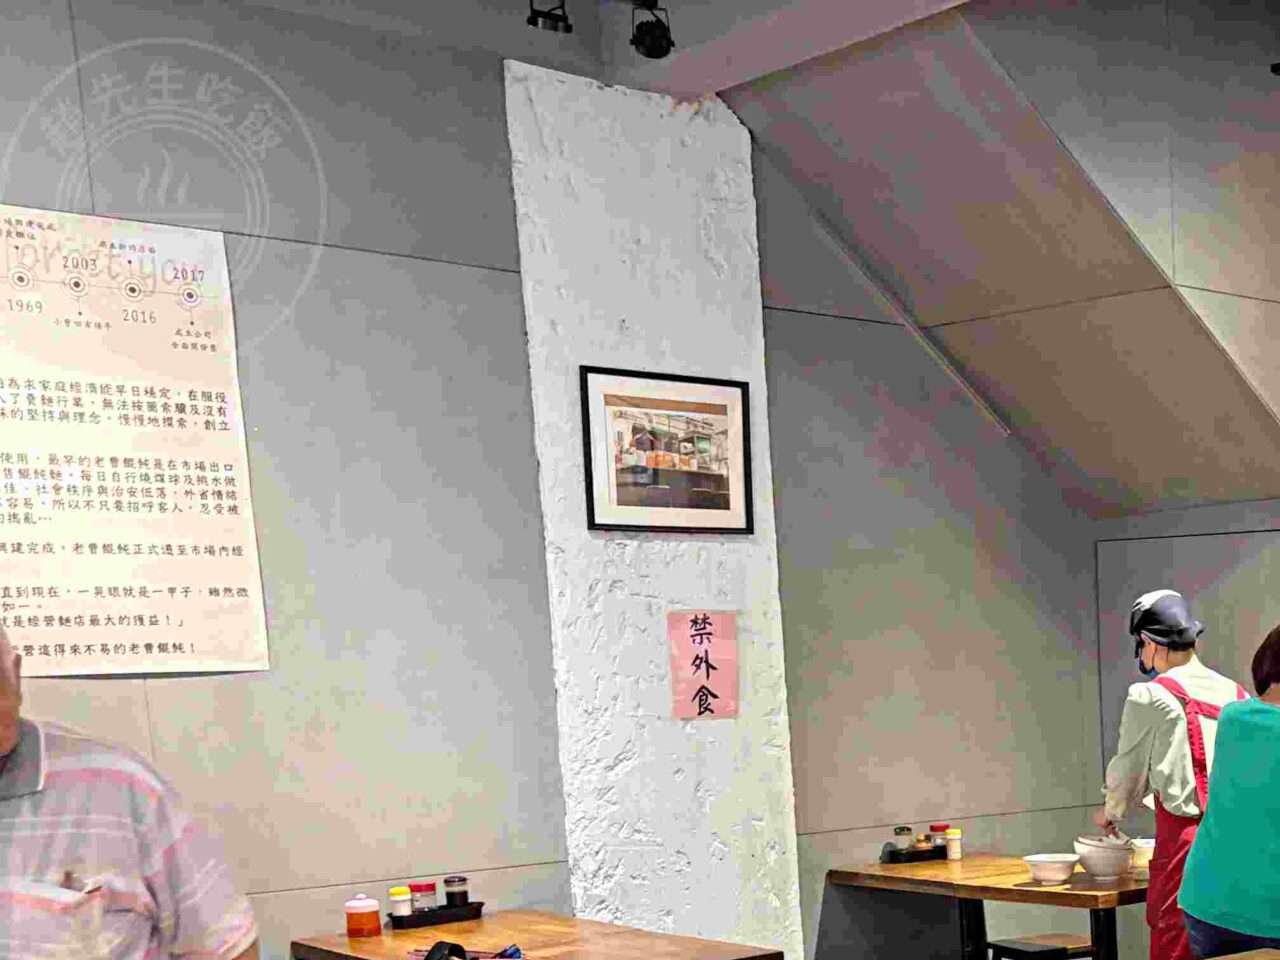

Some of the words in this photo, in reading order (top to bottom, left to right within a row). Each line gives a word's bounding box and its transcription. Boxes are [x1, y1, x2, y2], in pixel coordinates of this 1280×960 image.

[62, 255, 98, 271] 2003
[173, 267, 205, 282] 2017
[7, 299, 43, 314] 1969
[122, 309, 157, 324] 2016
[12, 642, 196, 657] 營這得來不易的老曹餛飩！
[689, 613, 720, 717] 禁外食
